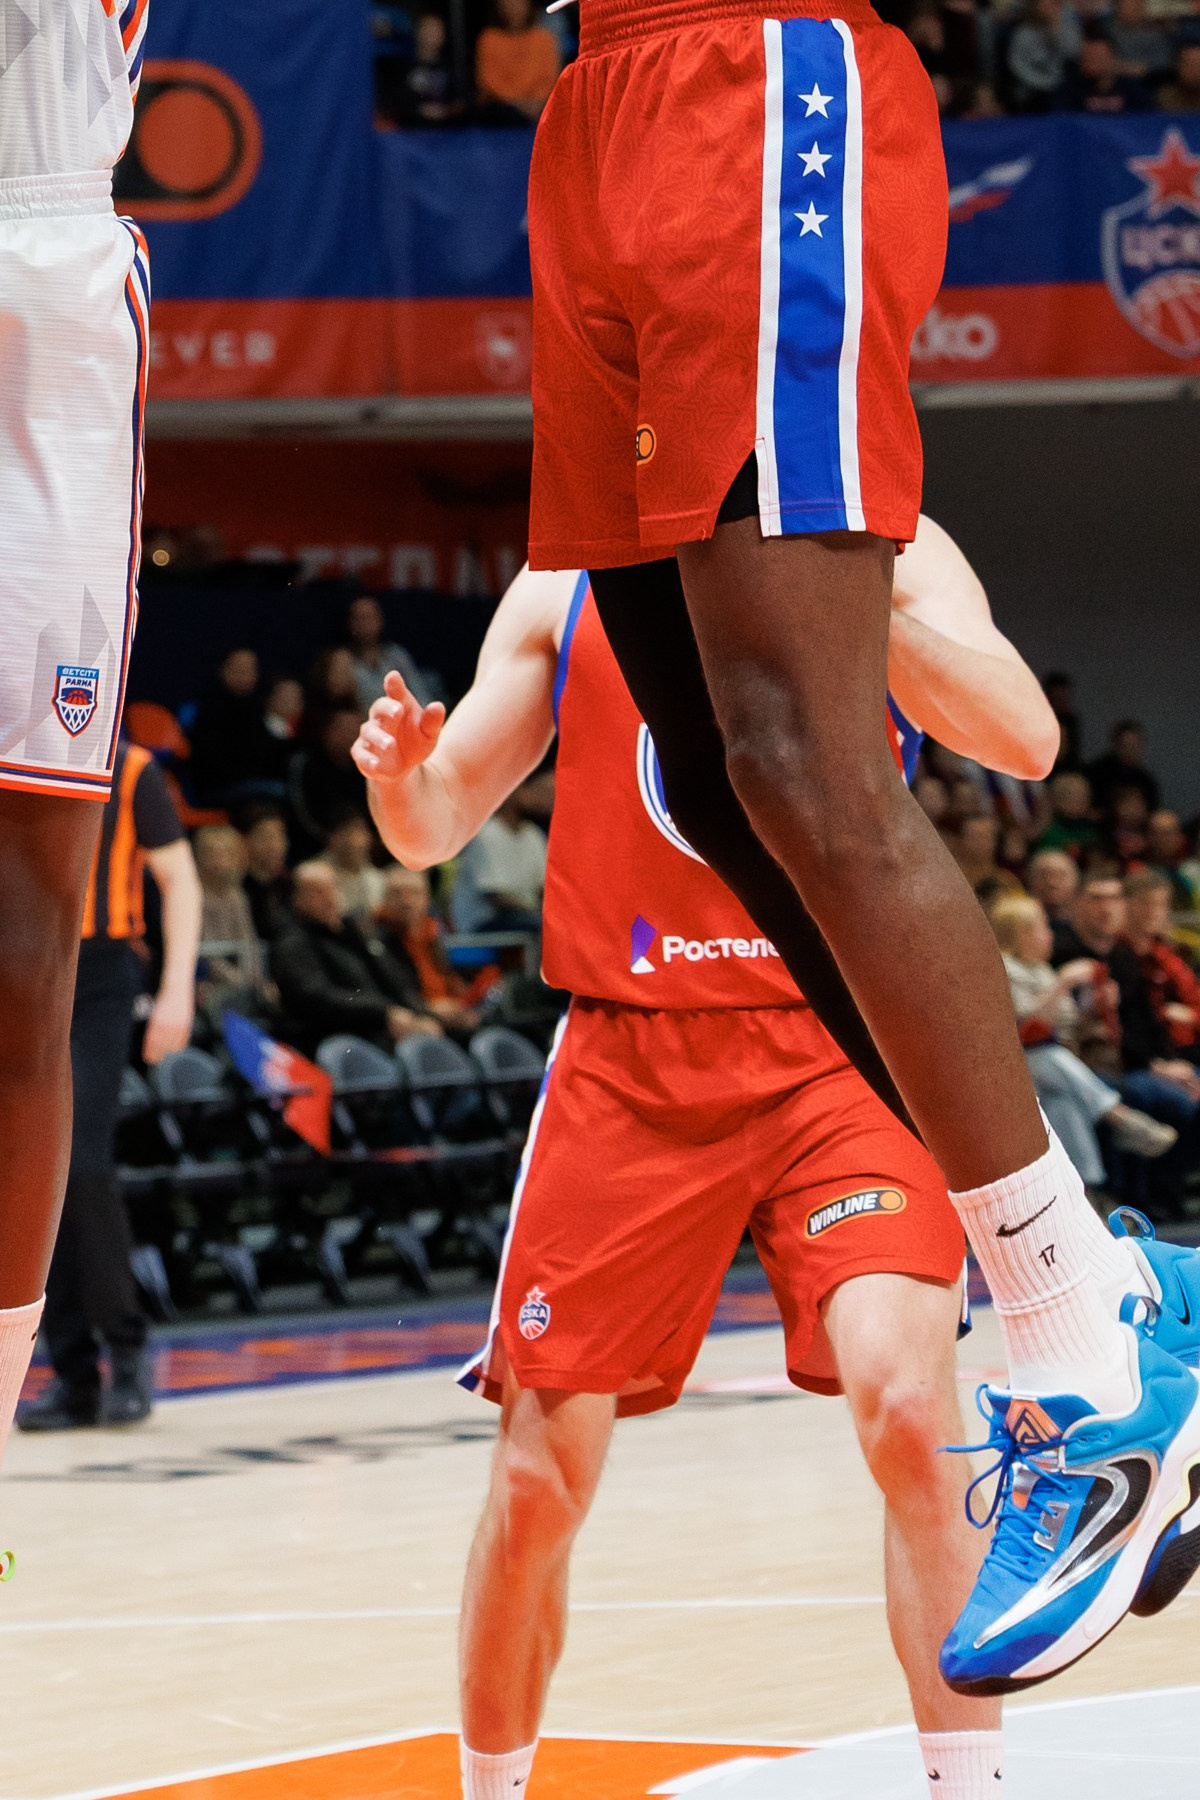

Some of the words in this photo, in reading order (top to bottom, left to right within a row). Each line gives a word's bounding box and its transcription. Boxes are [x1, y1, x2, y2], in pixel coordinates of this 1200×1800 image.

[62, 667, 97, 678] BETCITY
[65, 677, 92, 688] PARMA
[809, 1193, 878, 1234] WINLINE
[1038, 1243, 1055, 1267] 17
